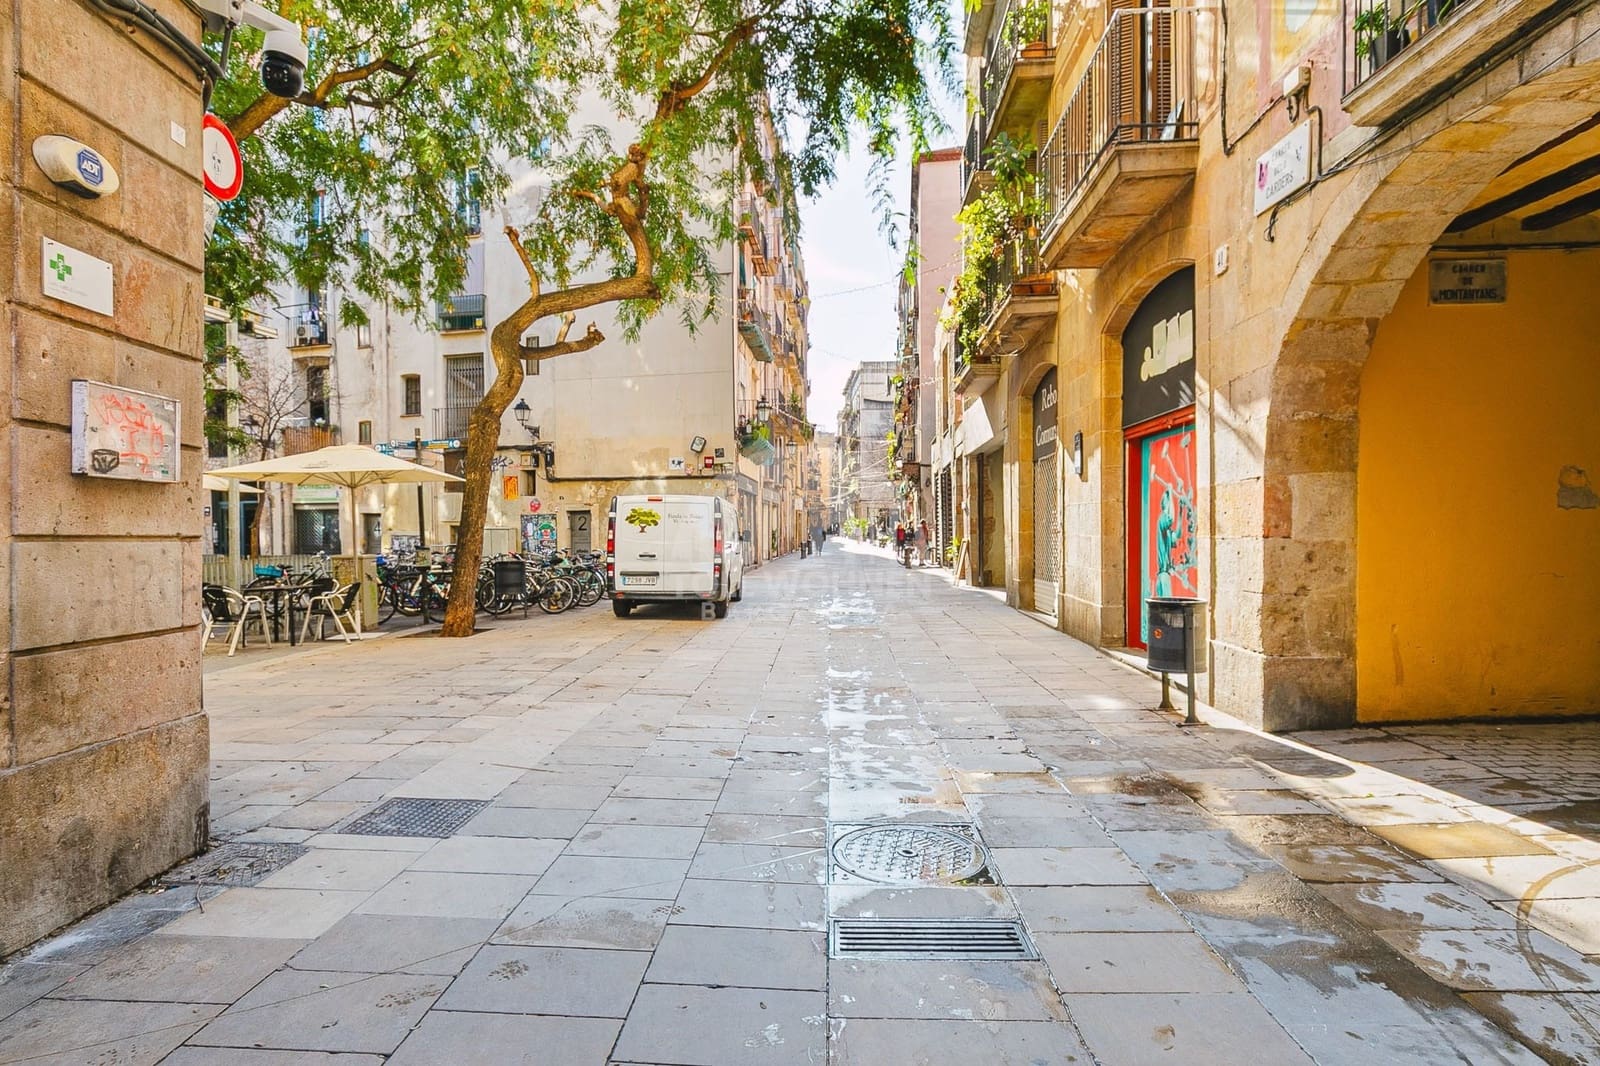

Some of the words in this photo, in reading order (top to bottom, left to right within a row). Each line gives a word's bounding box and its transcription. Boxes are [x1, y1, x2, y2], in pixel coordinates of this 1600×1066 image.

[81, 160, 100, 176] ADT
[1265, 170, 1293, 199] CARDERS
[373, 520, 382, 537] 4
[577, 515, 588, 531] 2
